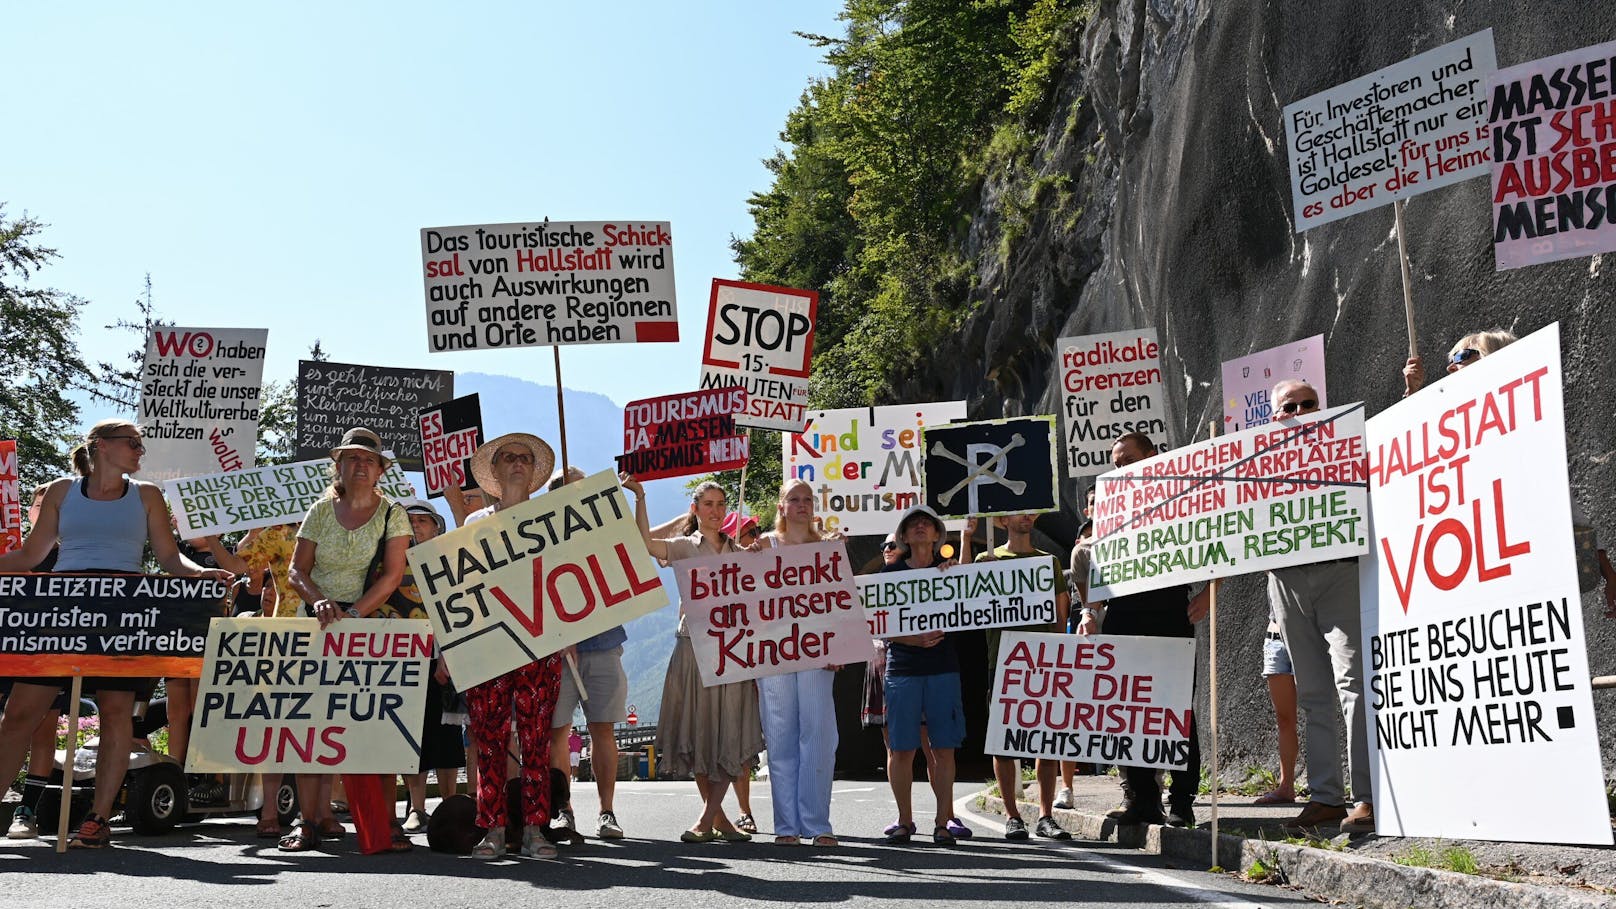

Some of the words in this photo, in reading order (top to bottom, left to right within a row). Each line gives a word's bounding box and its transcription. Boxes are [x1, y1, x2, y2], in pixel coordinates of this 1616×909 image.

[1293, 110, 1323, 133] Für
[1327, 76, 1422, 120] Investoren
[1432, 47, 1473, 81] und
[1489, 55, 1616, 123] MASSE
[1296, 78, 1480, 152] Geschäftemacher
[1296, 150, 1318, 176] ist
[1322, 119, 1410, 167] Hallstatt
[1414, 111, 1448, 136] nur
[1400, 139, 1430, 167] für
[1436, 130, 1470, 153] uns
[1475, 119, 1490, 140] is
[1493, 117, 1542, 163] IST
[1302, 200, 1324, 219] es
[1330, 182, 1378, 210] aber
[1385, 167, 1420, 192] die
[427, 230, 470, 254] Das
[476, 225, 595, 250] touristische
[426, 253, 464, 278] sal
[468, 257, 509, 275] von
[516, 247, 612, 273] Hallstatt
[618, 248, 665, 270] wird
[430, 278, 483, 302] auch
[491, 273, 649, 302] Auswirkungen
[431, 301, 469, 327] auf
[478, 299, 556, 323] andere
[566, 295, 672, 323] Regionen
[715, 303, 811, 352] STOP
[216, 340, 266, 359] haben
[433, 325, 477, 351] und
[485, 321, 536, 347] Orte
[547, 320, 621, 343] haben
[1063, 338, 1159, 368] radikale
[147, 359, 179, 377] sich
[183, 359, 206, 378] die
[305, 368, 322, 381] es
[326, 367, 367, 388] geht
[370, 371, 400, 387] uns
[403, 372, 445, 391] nicht
[1064, 368, 1162, 393] Grenzen
[144, 379, 192, 397] steckt
[193, 380, 217, 398] die
[221, 386, 261, 400] unser
[304, 384, 334, 396] um
[333, 384, 418, 402] politisches
[1065, 395, 1099, 418] für
[1110, 390, 1150, 414] den
[143, 399, 259, 421] Weltkulturerbe
[302, 412, 328, 423] um
[335, 413, 395, 428] unseren
[421, 412, 443, 441] ES
[625, 391, 745, 428] TOURISMUS
[743, 398, 808, 422] STATT
[1245, 404, 1272, 422] UND
[1367, 366, 1549, 488] HALLSTATT
[424, 428, 478, 466] REICHT
[614, 442, 704, 475] TOURISMUS
[709, 436, 749, 464] NEIN
[625, 428, 651, 454] JA
[791, 418, 859, 458] Kind
[176, 471, 264, 498] HALLSTATT
[273, 467, 295, 483] IST
[304, 459, 334, 480] DE
[426, 459, 466, 491] UNS
[790, 457, 815, 481] in
[824, 454, 872, 481] der
[1096, 494, 1126, 519] WIR
[1132, 467, 1224, 509] BRAUCHEN
[1236, 435, 1362, 482] PARKPLÄTZE
[1104, 472, 1136, 496] WIR
[1142, 440, 1242, 486] BRAUCHEN
[182, 492, 231, 513] BOTE
[242, 486, 277, 502] DER
[1096, 514, 1125, 539] WIR
[1131, 488, 1226, 530] BRAUCHEN
[1237, 459, 1368, 505] INVESTOREN
[1418, 455, 1470, 519] IST
[187, 511, 218, 530] EN
[1095, 537, 1130, 564] WIR
[1137, 508, 1254, 553] BRAUCHEN
[420, 486, 624, 596] HALLSTATT
[1381, 478, 1531, 617] VOLL
[0, 577, 26, 597] ER
[35, 577, 126, 598] LETZTER
[133, 577, 227, 599] AUSWEG
[489, 542, 663, 639] VOLL
[690, 563, 756, 600] bitte
[764, 551, 843, 589] denkt
[0, 605, 108, 628] Touristen
[120, 606, 161, 628] mit
[435, 583, 491, 634] IST
[709, 602, 750, 629] an
[759, 590, 852, 621] unsere
[2, 630, 88, 652] nismus
[100, 628, 208, 653] vertreibe
[217, 631, 311, 657] KEINE
[322, 632, 435, 658] NEUEN
[707, 623, 836, 677] Kinder
[1371, 628, 1421, 671] BITTE
[1427, 597, 1572, 661] BESUCHEN
[212, 659, 421, 687] PARKPLÄTZE
[1003, 641, 1116, 671] ALLES
[1001, 668, 1074, 699] FÜR
[1092, 673, 1153, 704] DIE
[1371, 671, 1404, 711] SIE
[1411, 663, 1465, 706] UNS
[1472, 648, 1575, 699] HEUTE
[200, 692, 314, 728] PLATZ
[999, 698, 1193, 739] TOURISTEN
[235, 726, 347, 766] UNS
[1004, 728, 1082, 757] NICHTS
[1086, 734, 1133, 761] FÜR
[1142, 738, 1190, 767] UNS
[1375, 709, 1438, 750] NICHT
